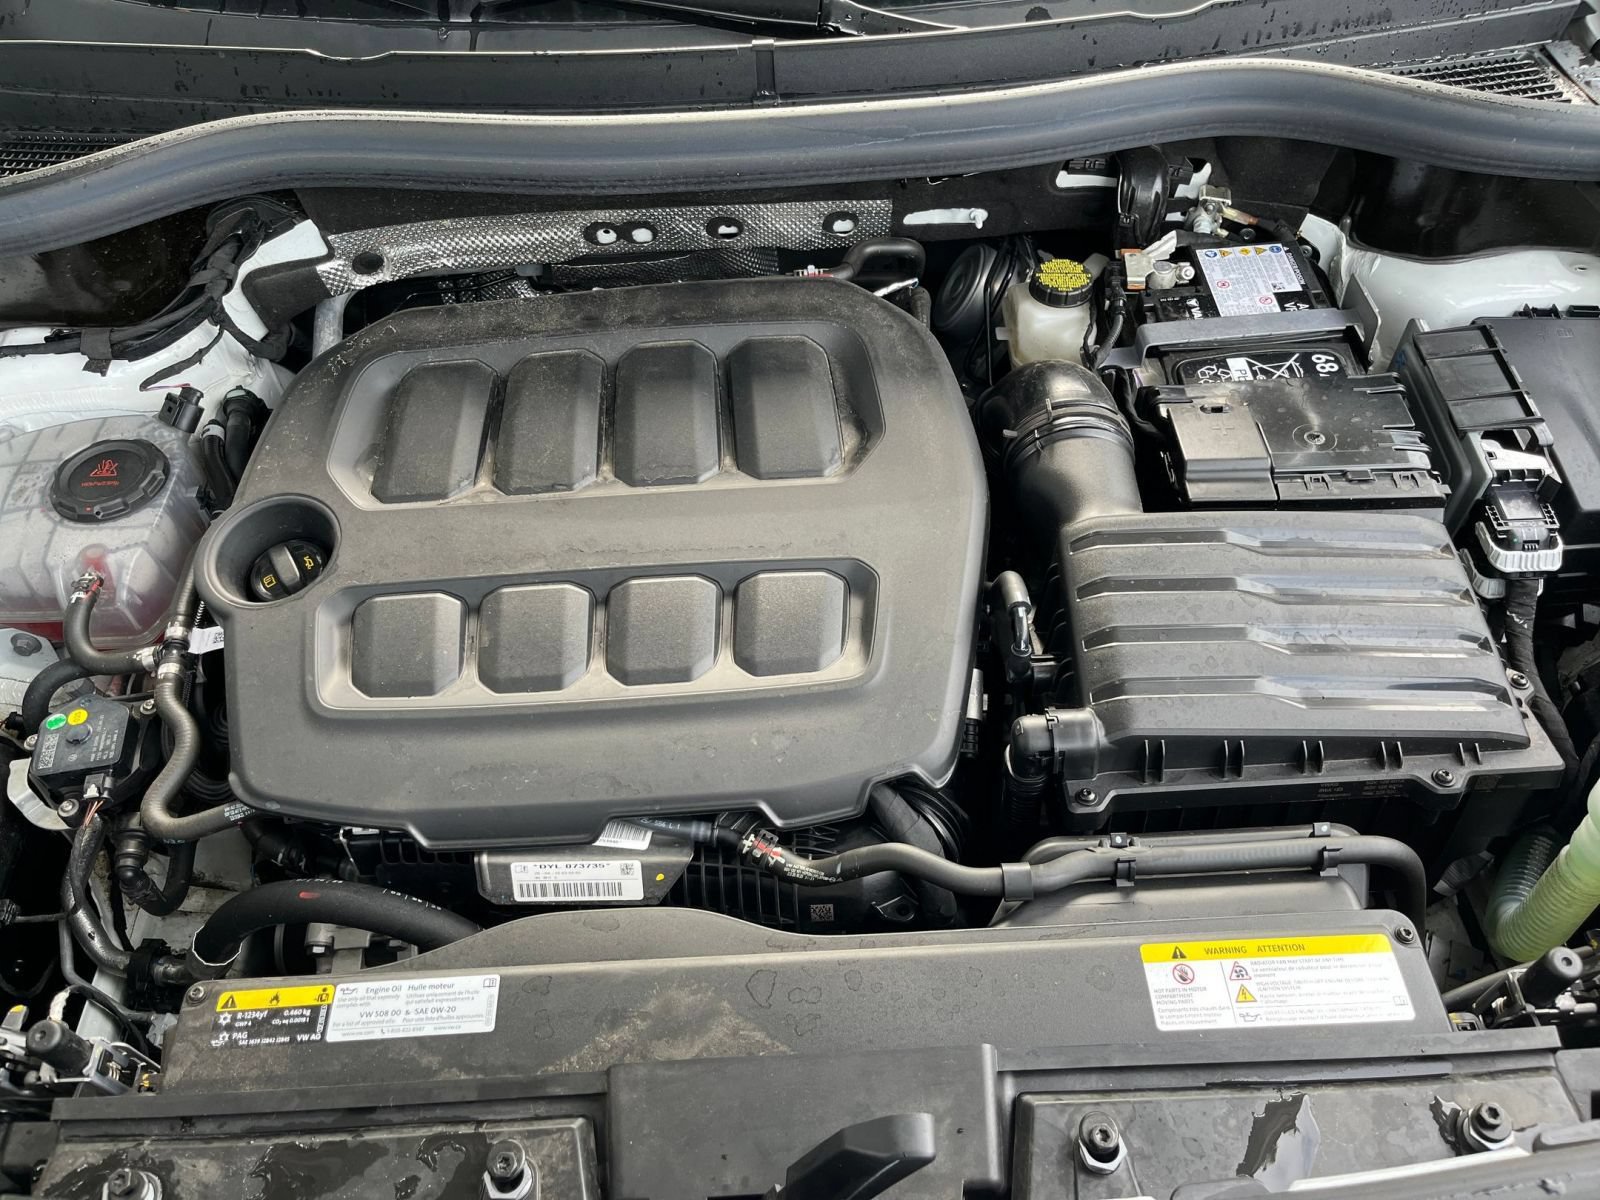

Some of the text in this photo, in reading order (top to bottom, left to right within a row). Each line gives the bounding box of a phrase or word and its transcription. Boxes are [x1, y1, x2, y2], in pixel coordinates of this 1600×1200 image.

[1204, 944, 1306, 955] WARNING ATTENTION
[366, 987, 390, 995] Engine
[391, 985, 402, 993] Oil
[236, 1010, 268, 1020] R-1234yf
[302, 1008, 311, 1016] kg
[414, 1007, 429, 1015] SAE
[232, 1031, 322, 1042] PAG VW AG
